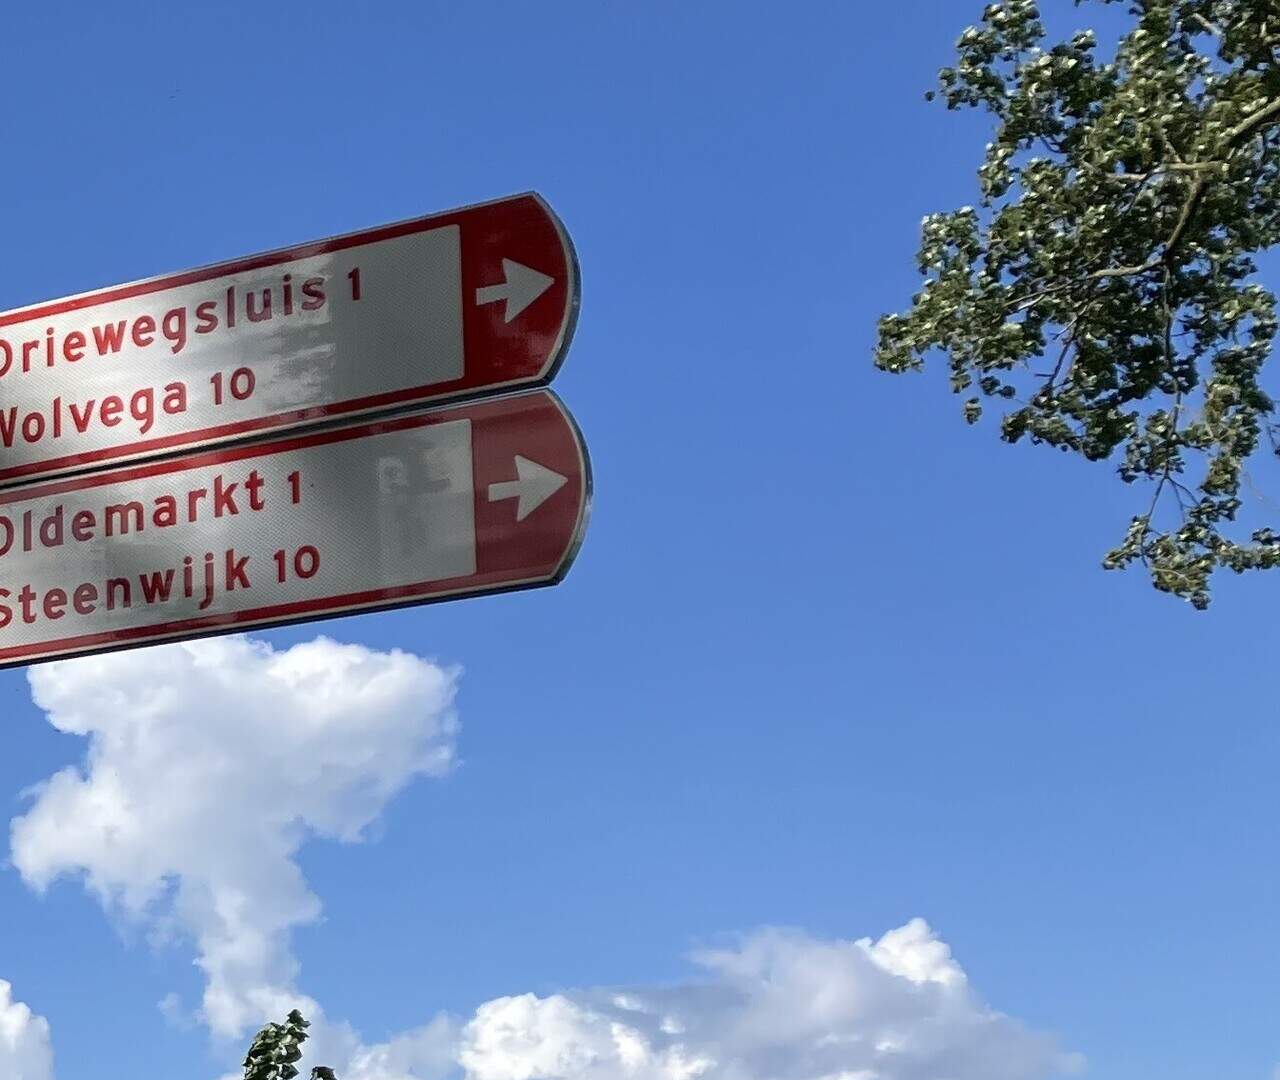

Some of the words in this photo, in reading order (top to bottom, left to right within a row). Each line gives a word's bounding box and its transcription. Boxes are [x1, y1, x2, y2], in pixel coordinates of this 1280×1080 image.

[347, 267, 361, 302] 1
[211, 367, 257, 407] 10
[287, 470, 303, 505] 1
[273, 544, 322, 584] 10
